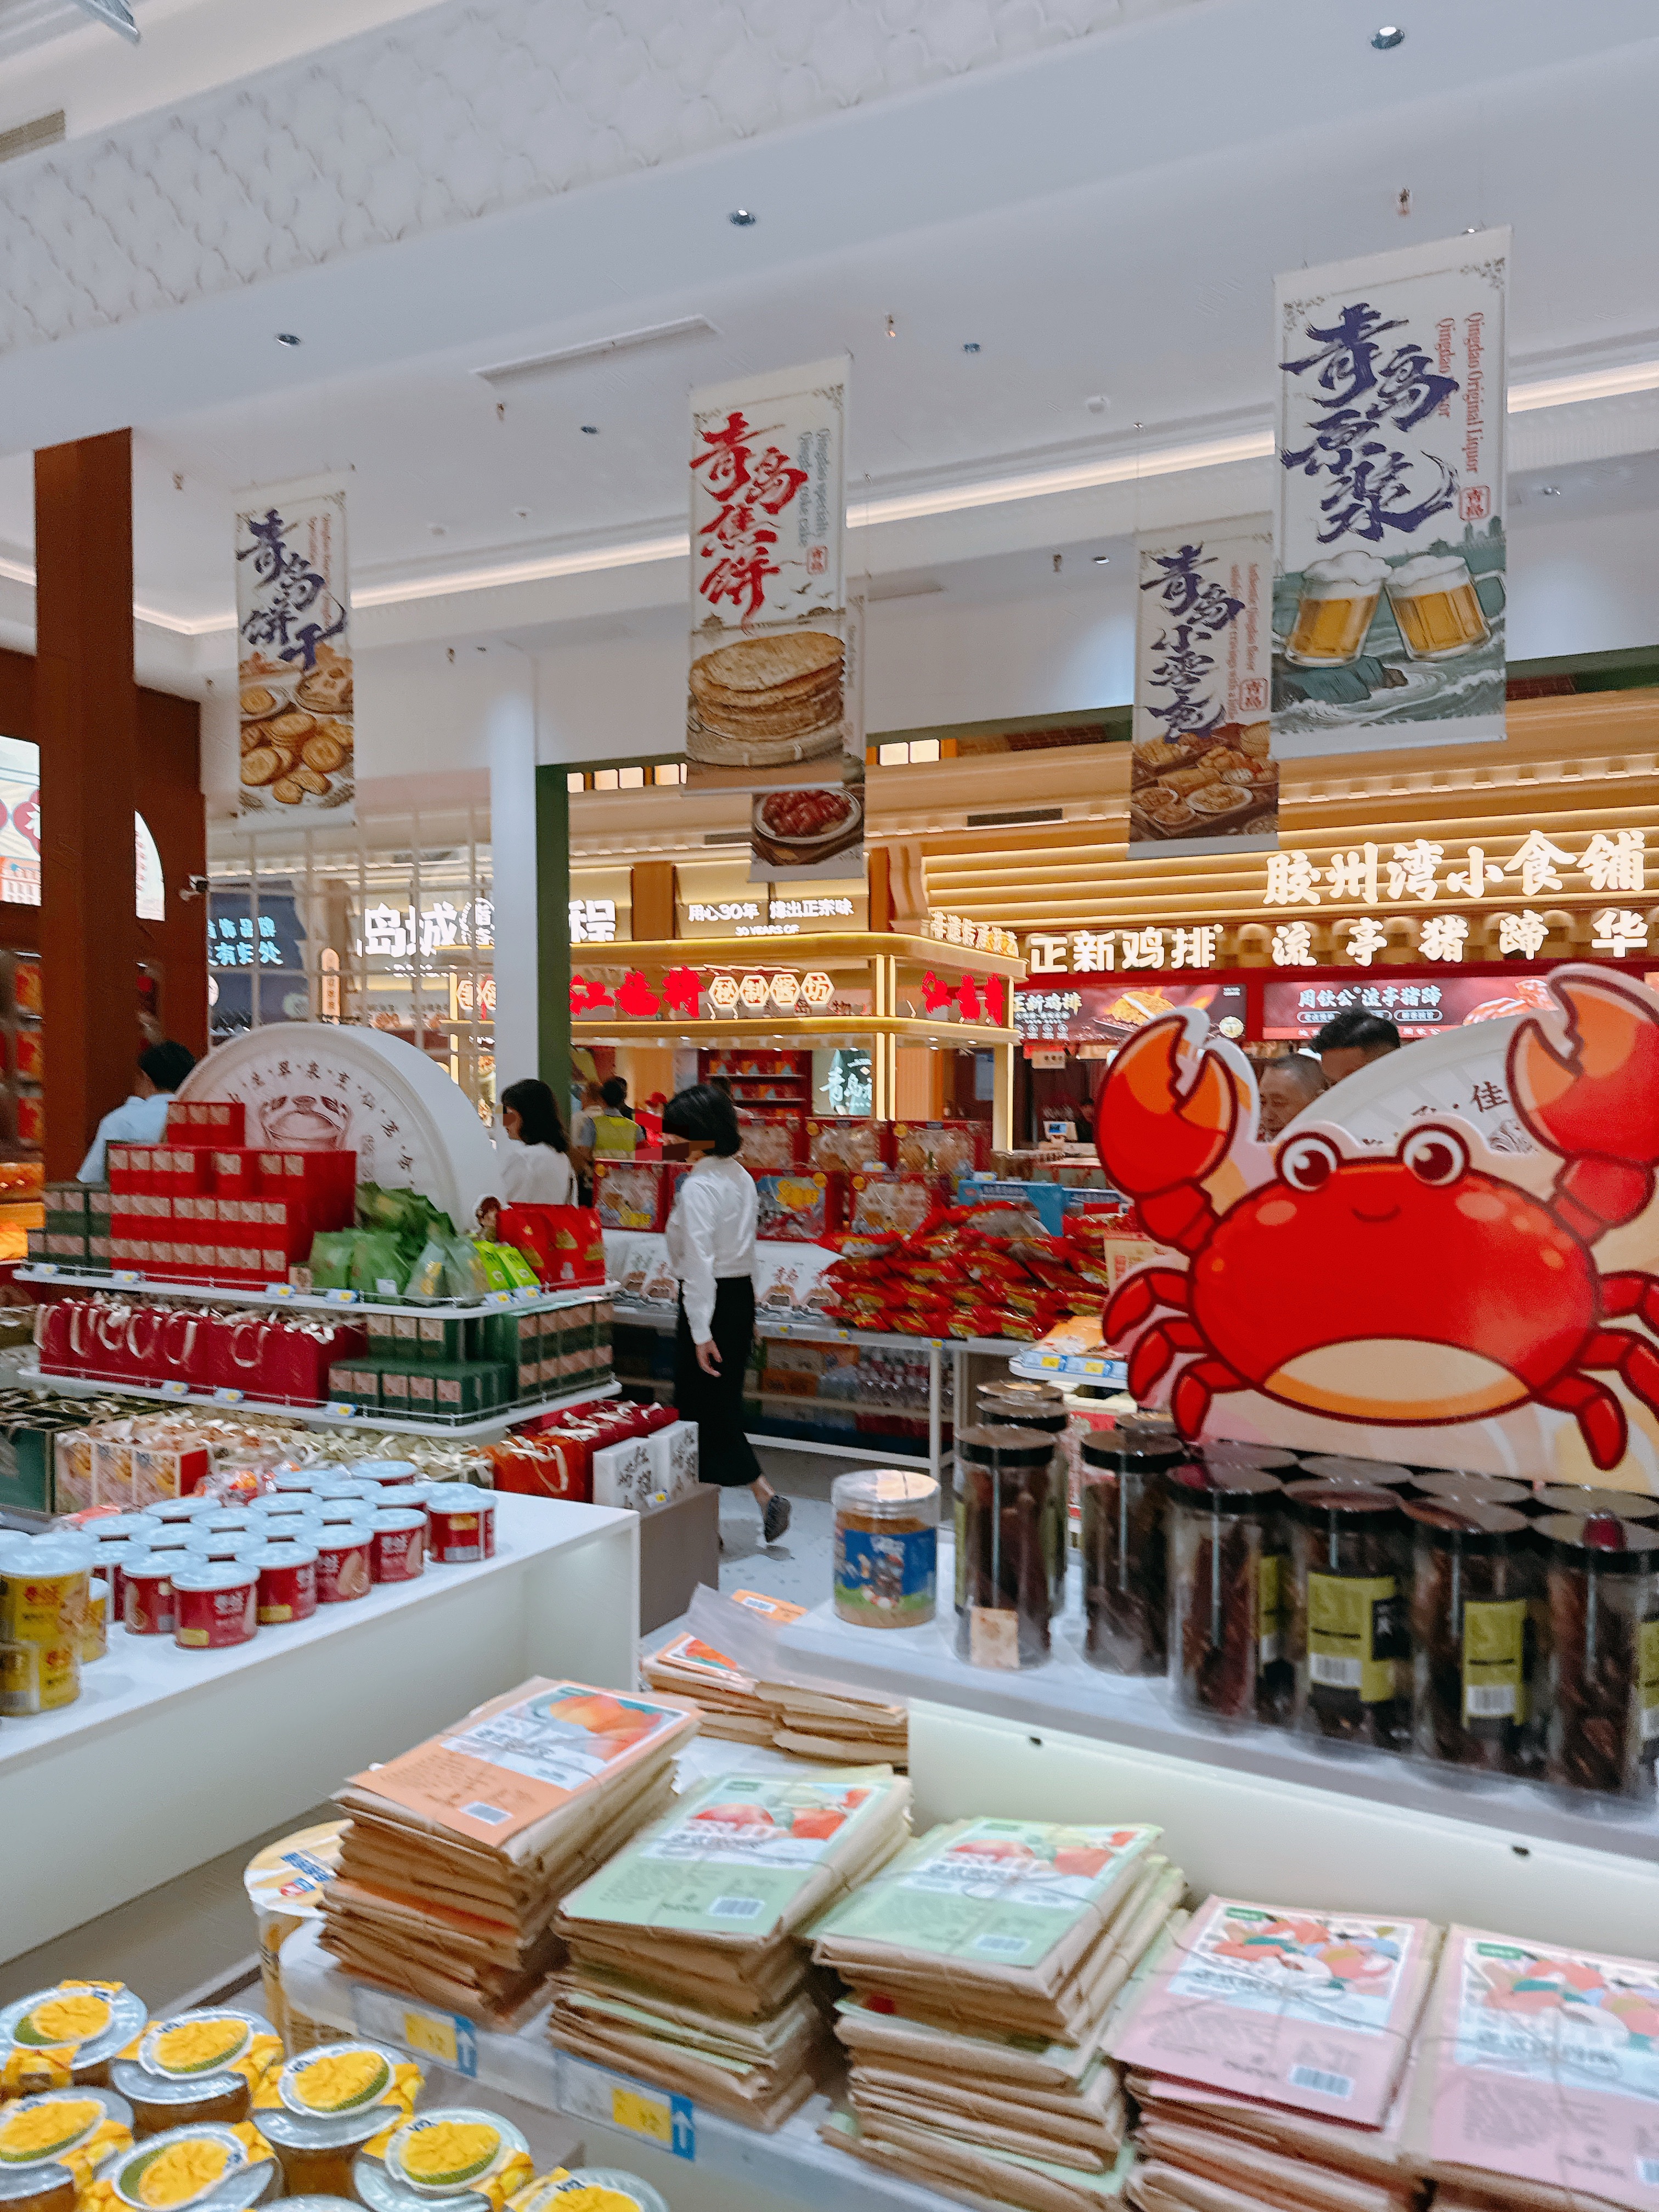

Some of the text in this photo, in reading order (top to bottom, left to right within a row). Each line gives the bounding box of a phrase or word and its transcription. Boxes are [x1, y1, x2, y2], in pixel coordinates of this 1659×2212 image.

[1463, 312, 1485, 369] Qingdao
[1463, 370, 1485, 427] Original
[1463, 428, 1484, 474] Liquor
[1263, 830, 1645, 905] 胶州湾小食铺
[1030, 927, 1217, 974] 正新鸡排
[1272, 909, 1549, 967] 流亭猪蹄
[1592, 911, 1648, 958] 华
[1470, 1081, 1509, 1113] 佳
